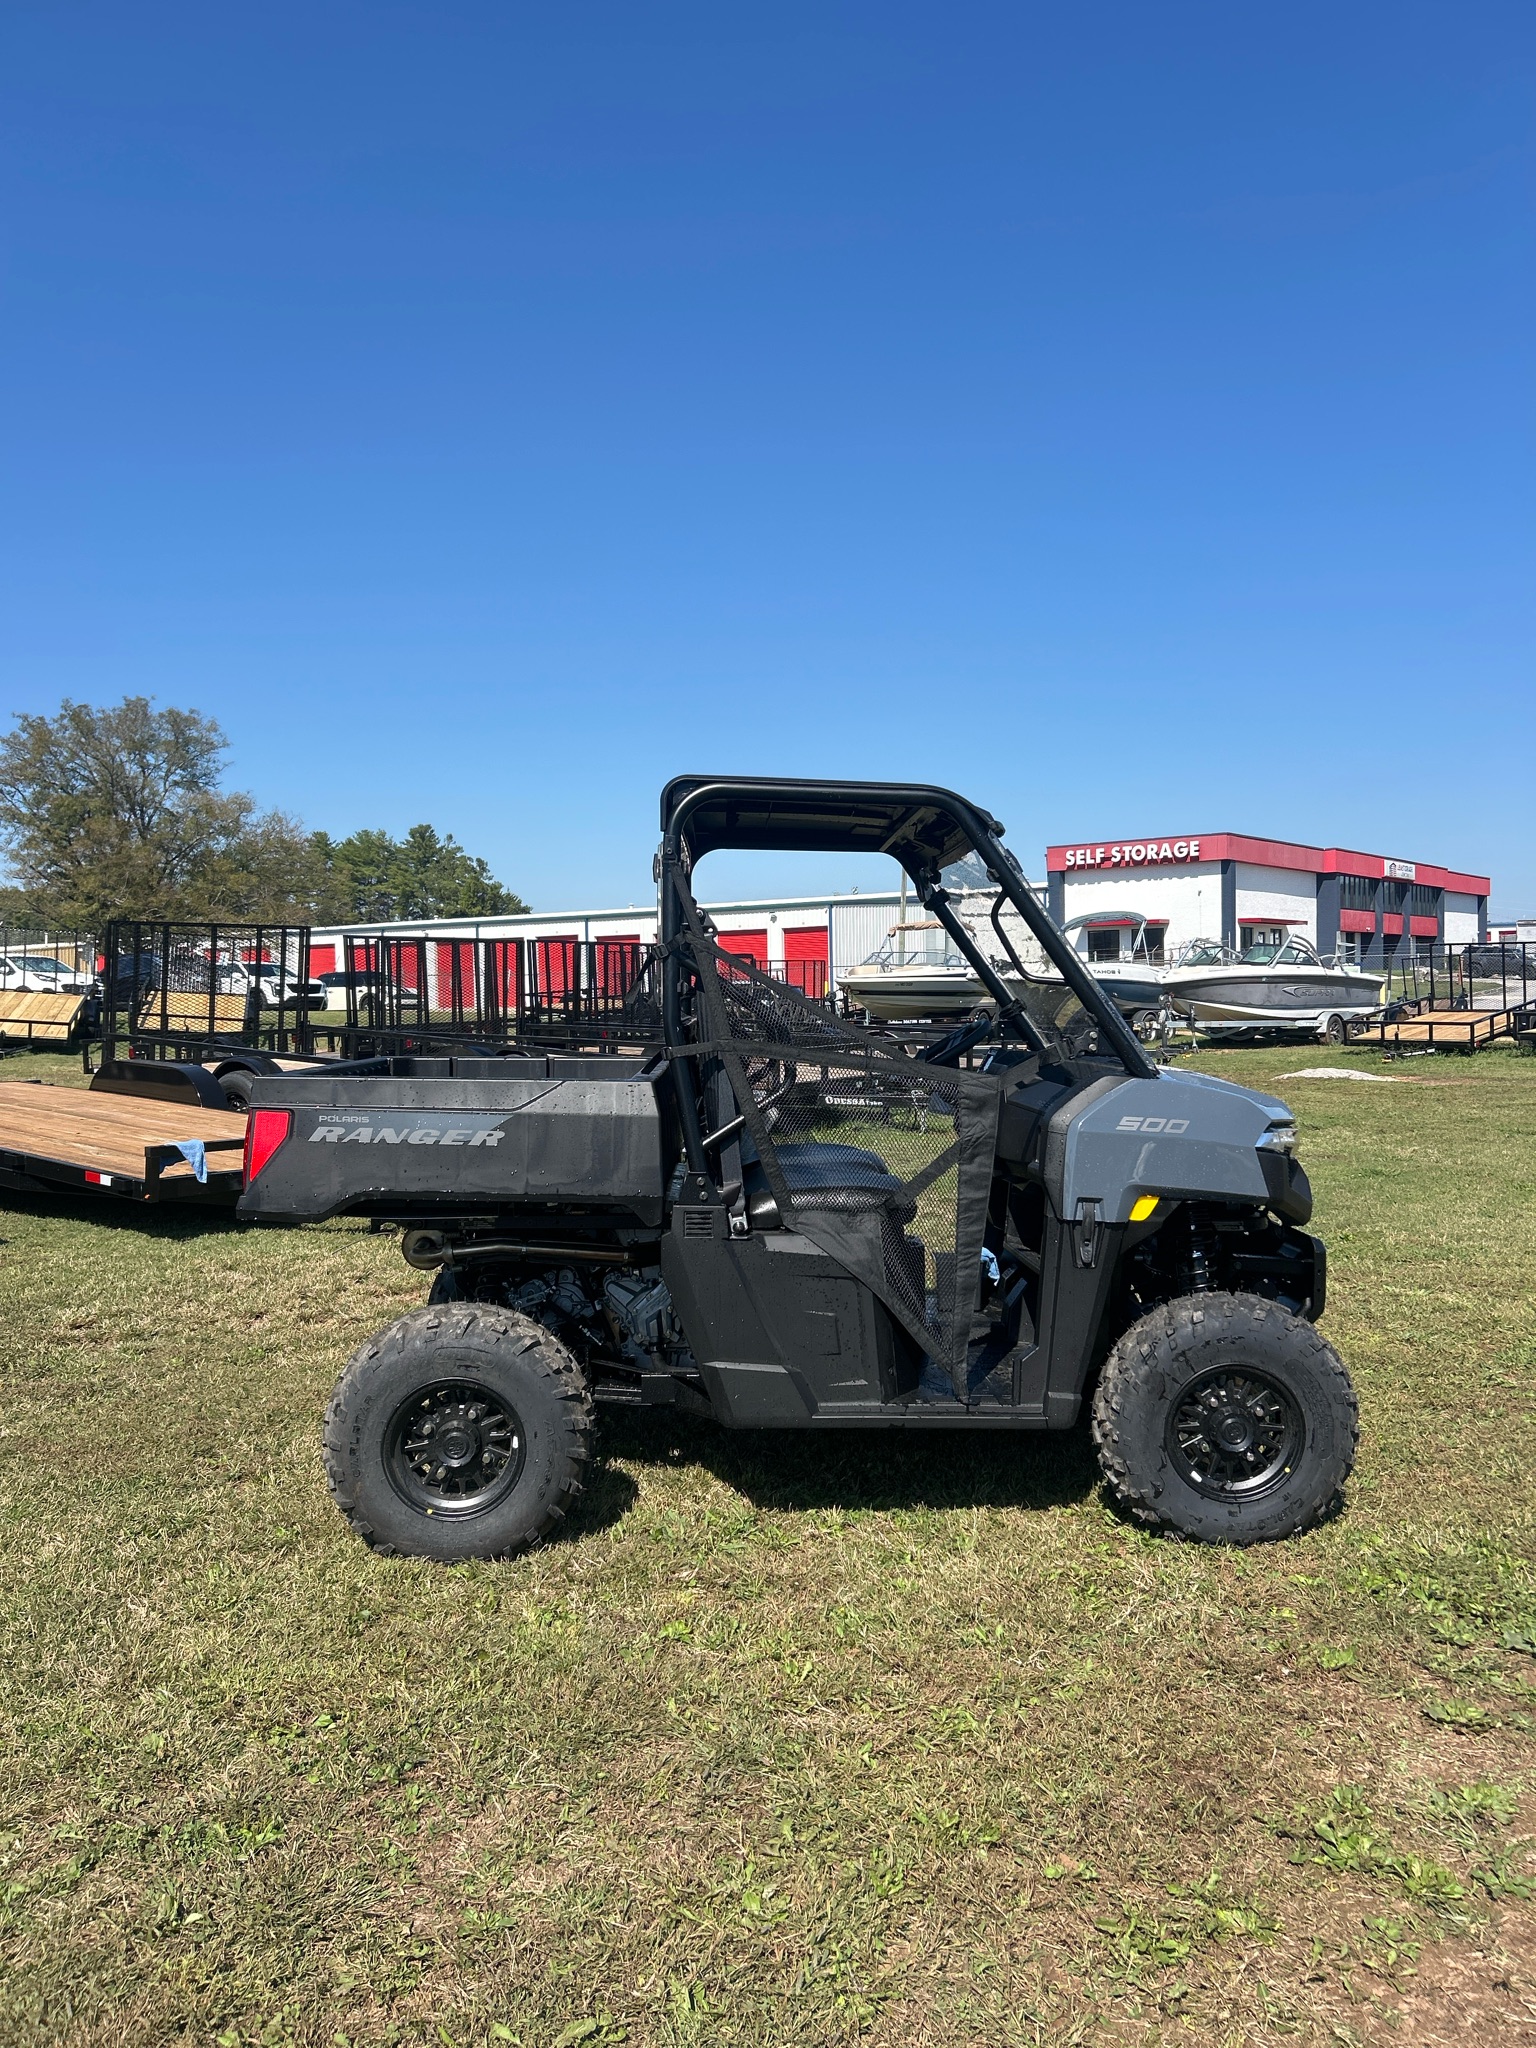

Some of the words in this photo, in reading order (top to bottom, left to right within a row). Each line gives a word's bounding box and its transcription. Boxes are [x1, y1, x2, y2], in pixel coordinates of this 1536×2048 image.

[1065, 848, 1105, 866] SELF
[1111, 840, 1200, 863] STORAGE
[318, 1115, 370, 1124] POLARIS
[1115, 1116, 1190, 1134] 500
[308, 1126, 506, 1147] RANGER
